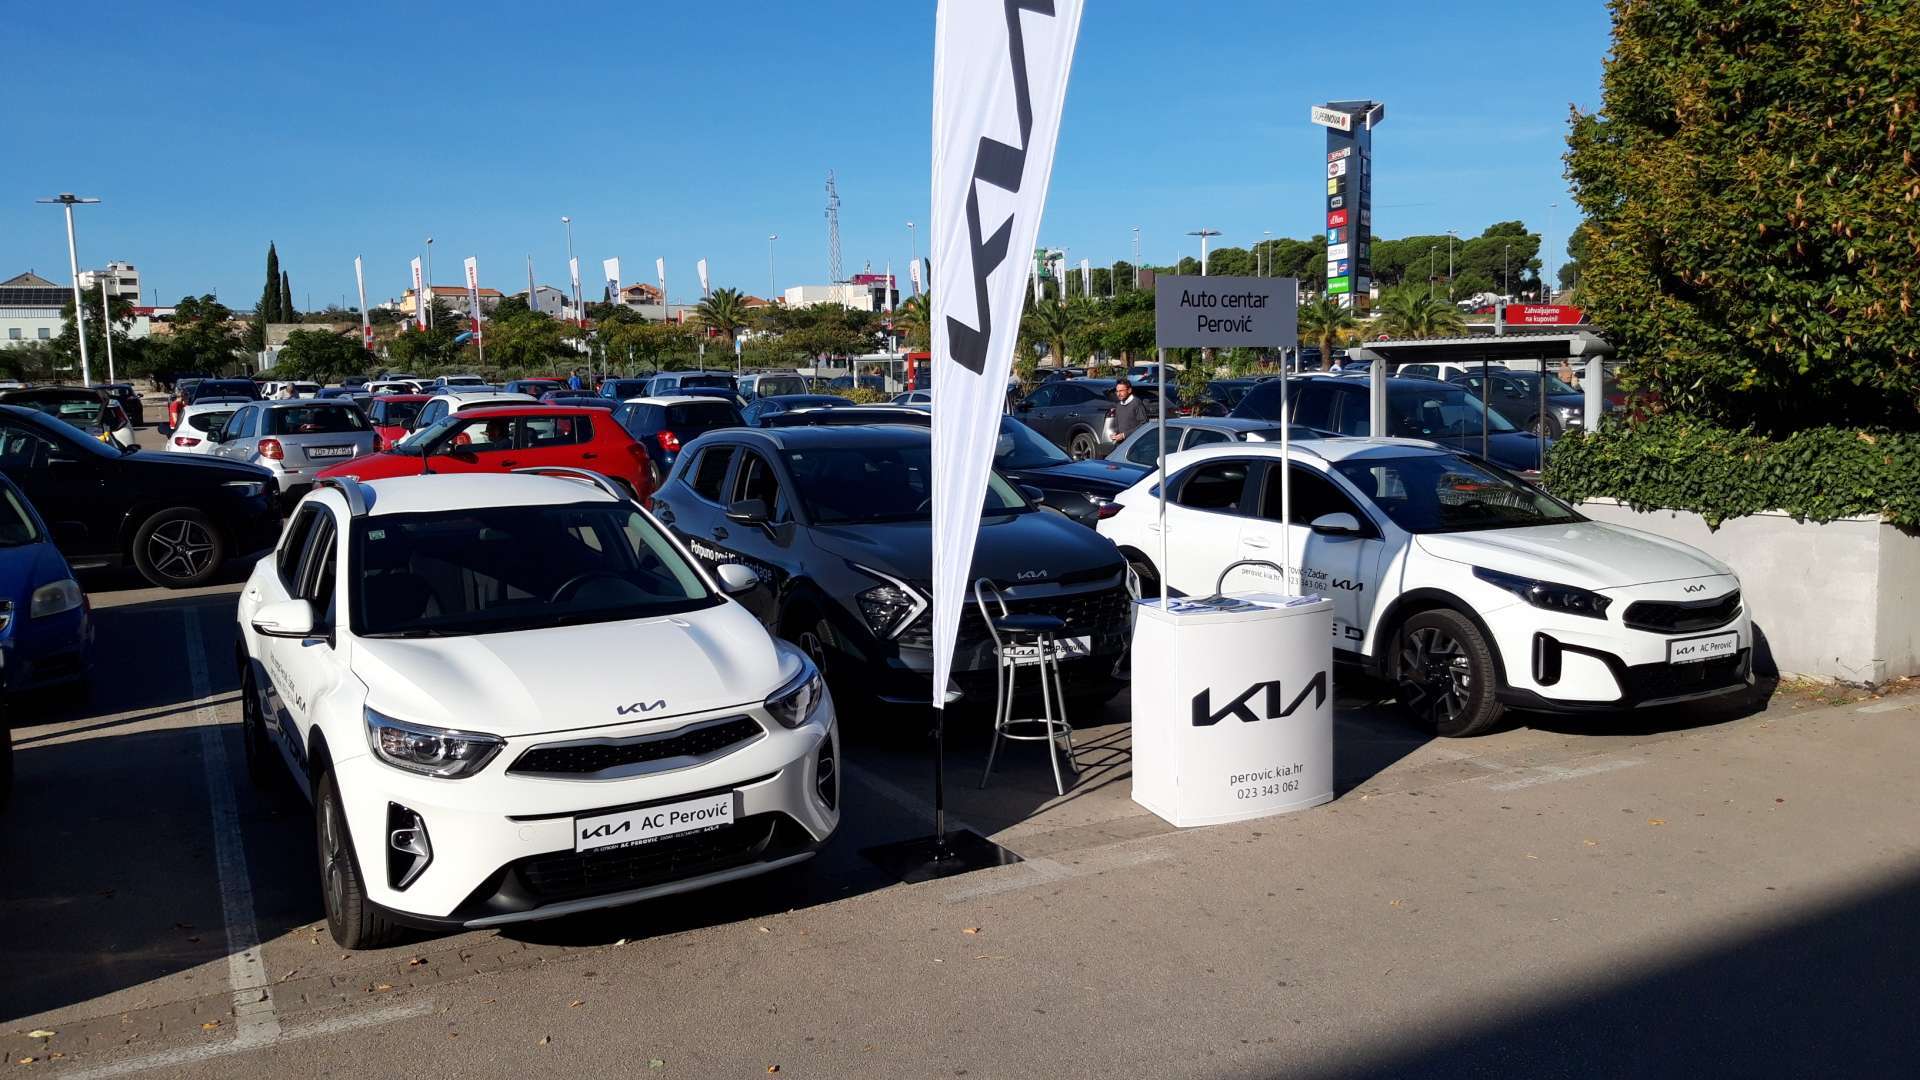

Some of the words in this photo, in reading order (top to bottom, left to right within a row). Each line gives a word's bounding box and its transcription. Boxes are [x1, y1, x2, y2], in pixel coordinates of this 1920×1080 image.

[1180, 290, 1217, 308] Auto
[1221, 291, 1269, 309] centar
[1197, 315, 1253, 333] Perović
[1017, 569, 1047, 580] KIA
[1332, 578, 1364, 592] KIA
[1676, 646, 1695, 655] KIA
[1700, 643, 1709, 652] AC
[1710, 640, 1732, 651] Perović
[617, 700, 666, 715] KIA
[1192, 671, 1326, 726] KIA
[1230, 763, 1304, 787] perovic.kia.hr
[1237, 787, 1258, 800] 023
[1261, 783, 1279, 797] 343
[1282, 780, 1299, 793] 062
[582, 820, 631, 840] KIA
[641, 814, 665, 831] AC
[670, 802, 728, 825] Perović
[620, 841, 630, 849] AC
